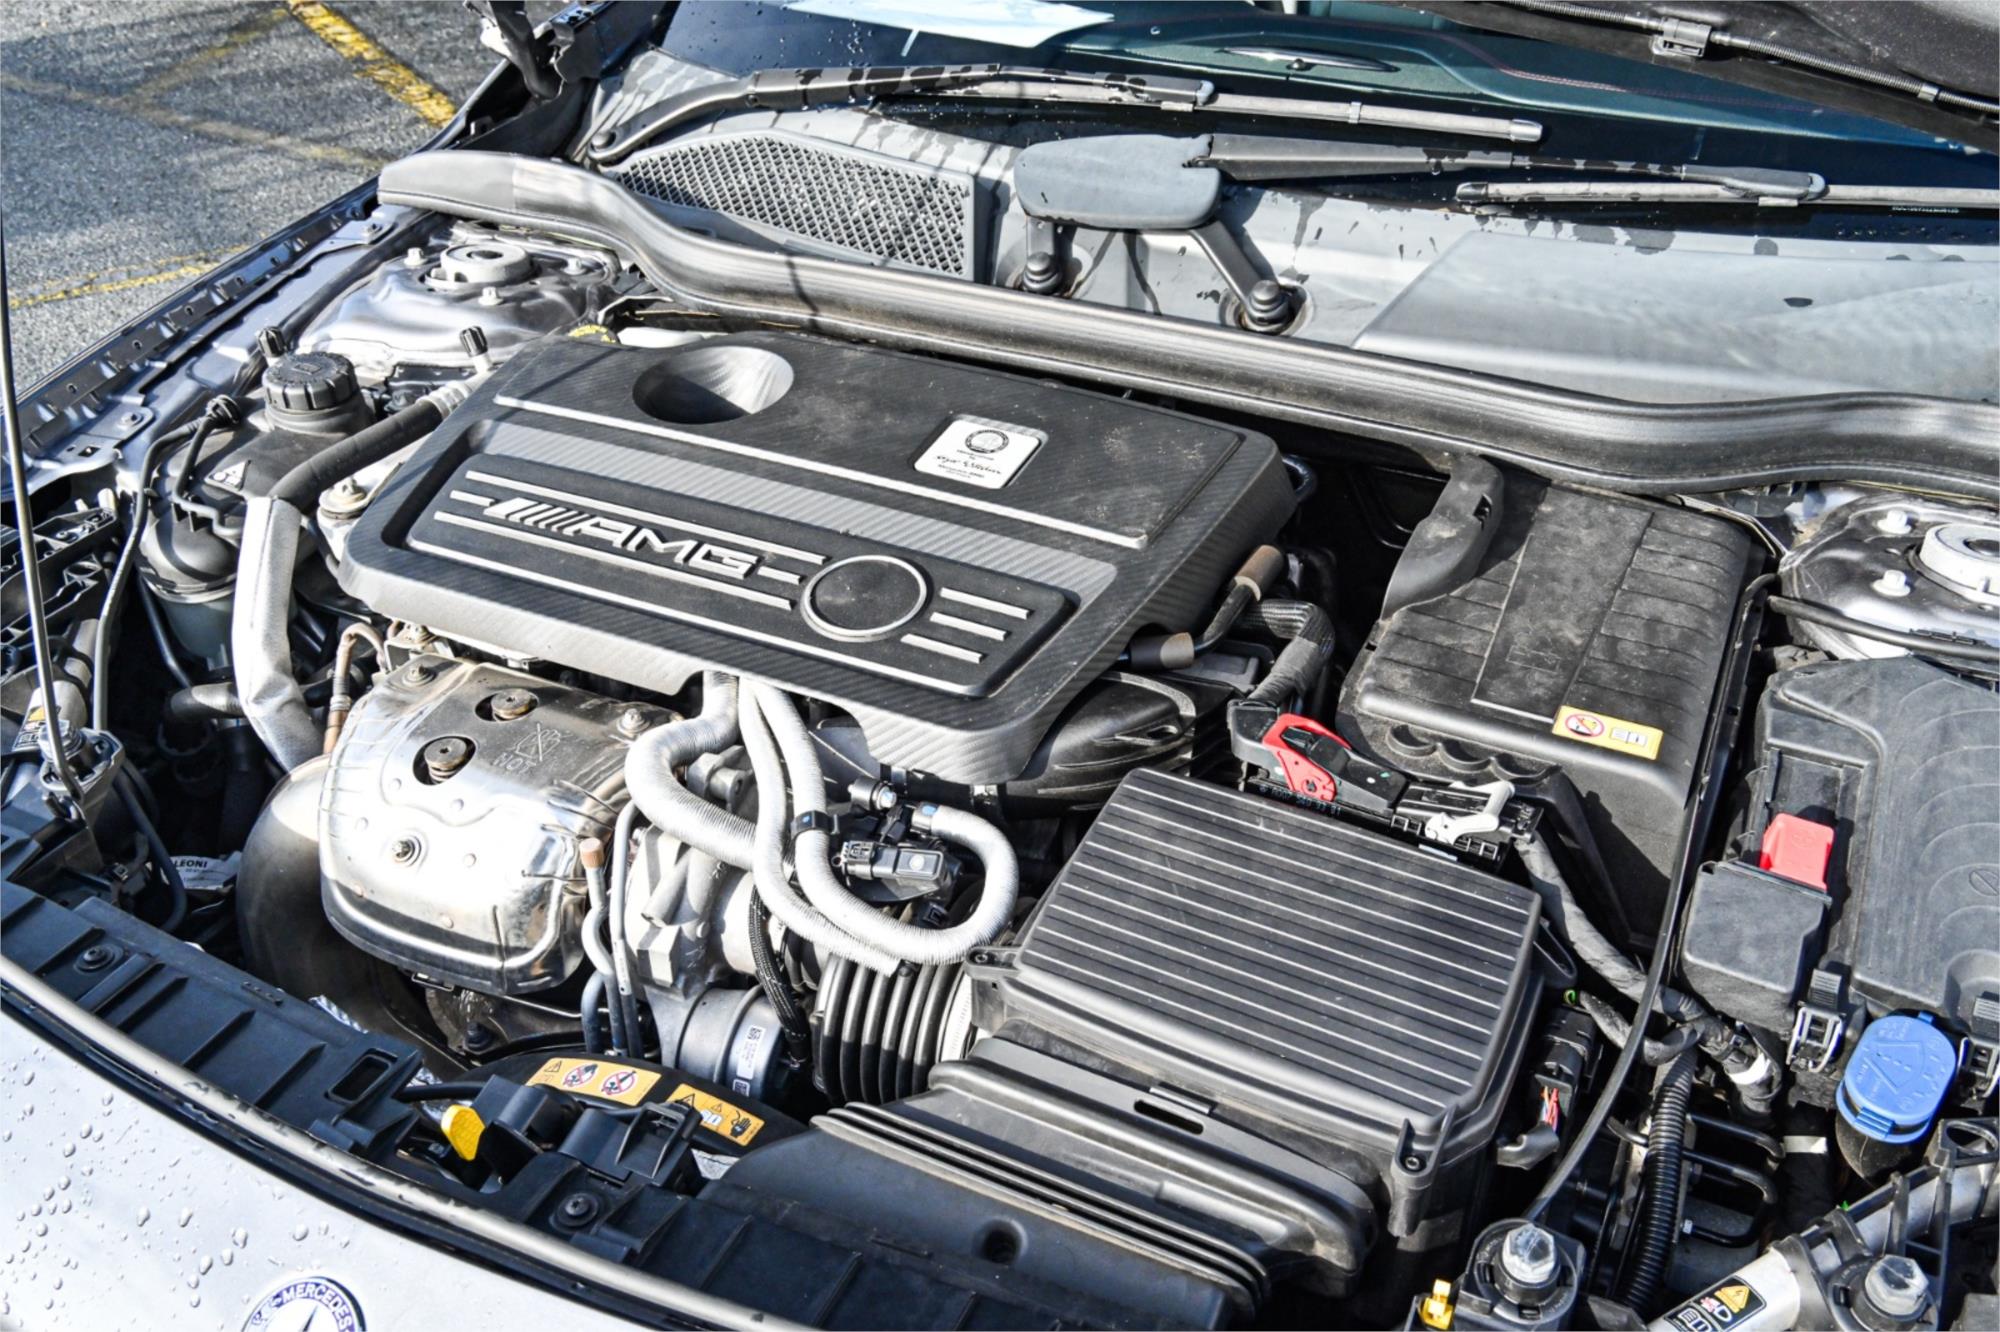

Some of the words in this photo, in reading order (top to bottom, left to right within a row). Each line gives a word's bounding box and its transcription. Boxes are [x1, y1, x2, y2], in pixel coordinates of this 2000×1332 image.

[566, 516, 757, 580] AMG
[174, 860, 208, 868] LEONI
[281, 1283, 353, 1331] MERCEDES
